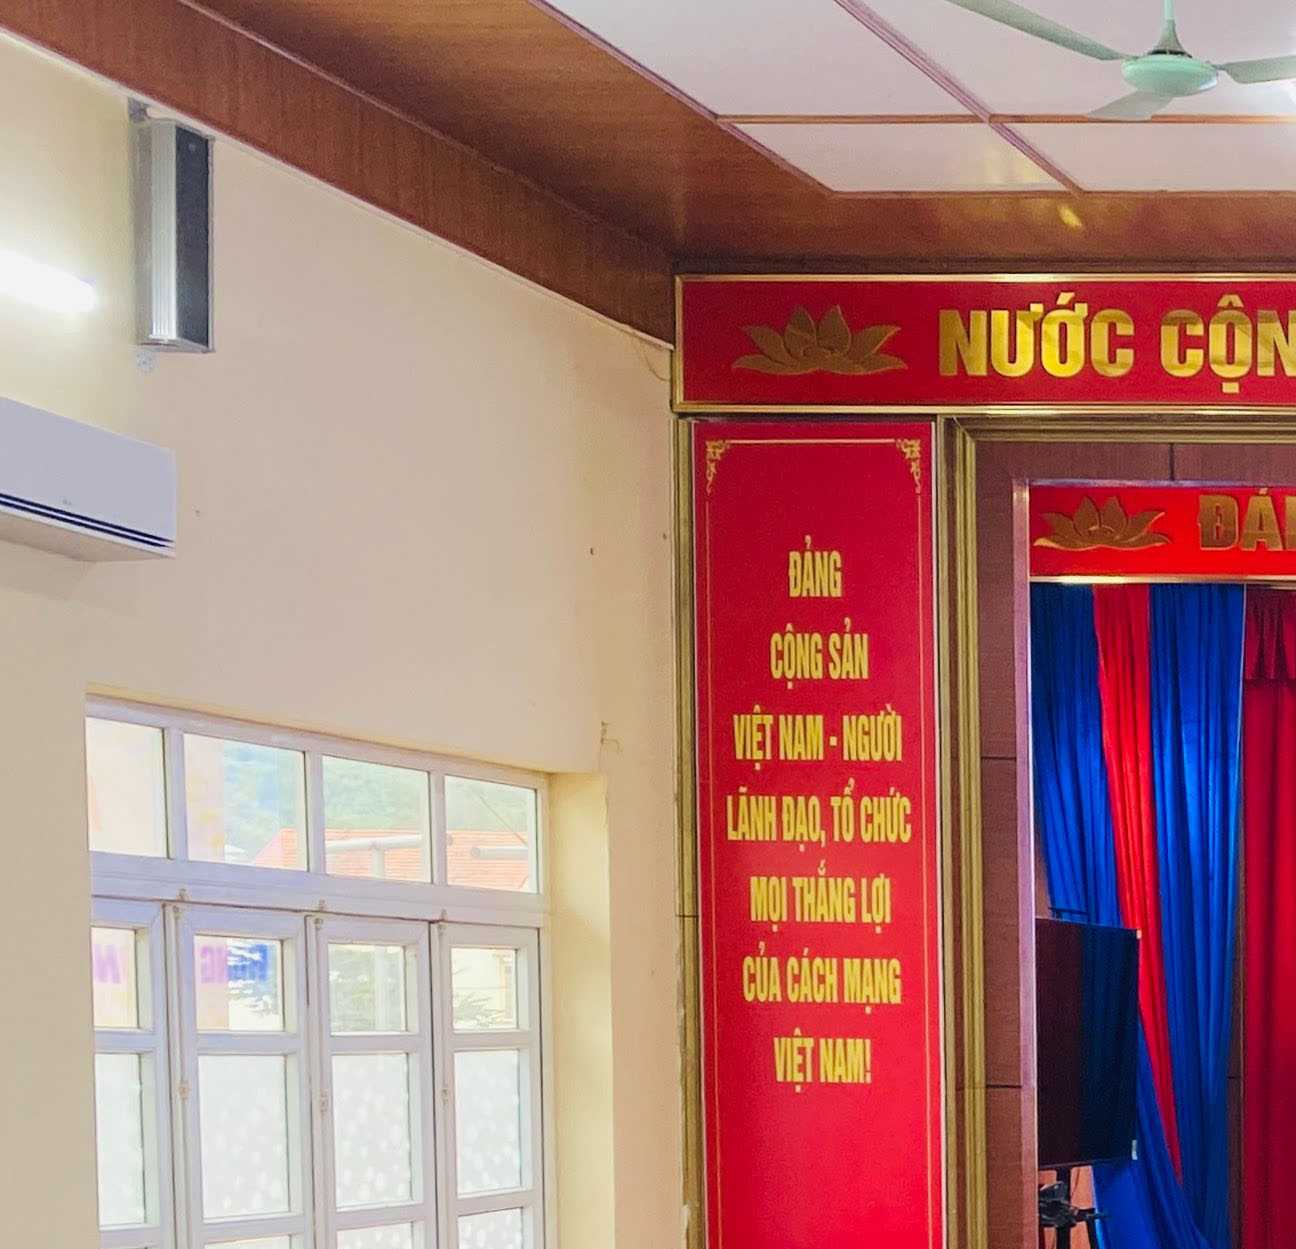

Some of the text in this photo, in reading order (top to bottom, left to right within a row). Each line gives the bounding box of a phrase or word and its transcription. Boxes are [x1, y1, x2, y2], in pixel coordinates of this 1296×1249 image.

[938, 292, 1133, 377] NƯỚC
[788, 535, 842, 597] ĐẢNG
[770, 617, 868, 689] CỘNG SẢN
[733, 705, 773, 771] VIỆT
[779, 715, 823, 760] NAM
[843, 703, 902, 761] NGƯỜI
[727, 778, 912, 852] LÃNH ĐẠO, TỔ CHỨC
[750, 859, 891, 934] MỌI THẮNG LỢI
[742, 941, 901, 1014] CỦA CÁCH MẠNG
[774, 1027, 872, 1093] VIỆT NAM!
